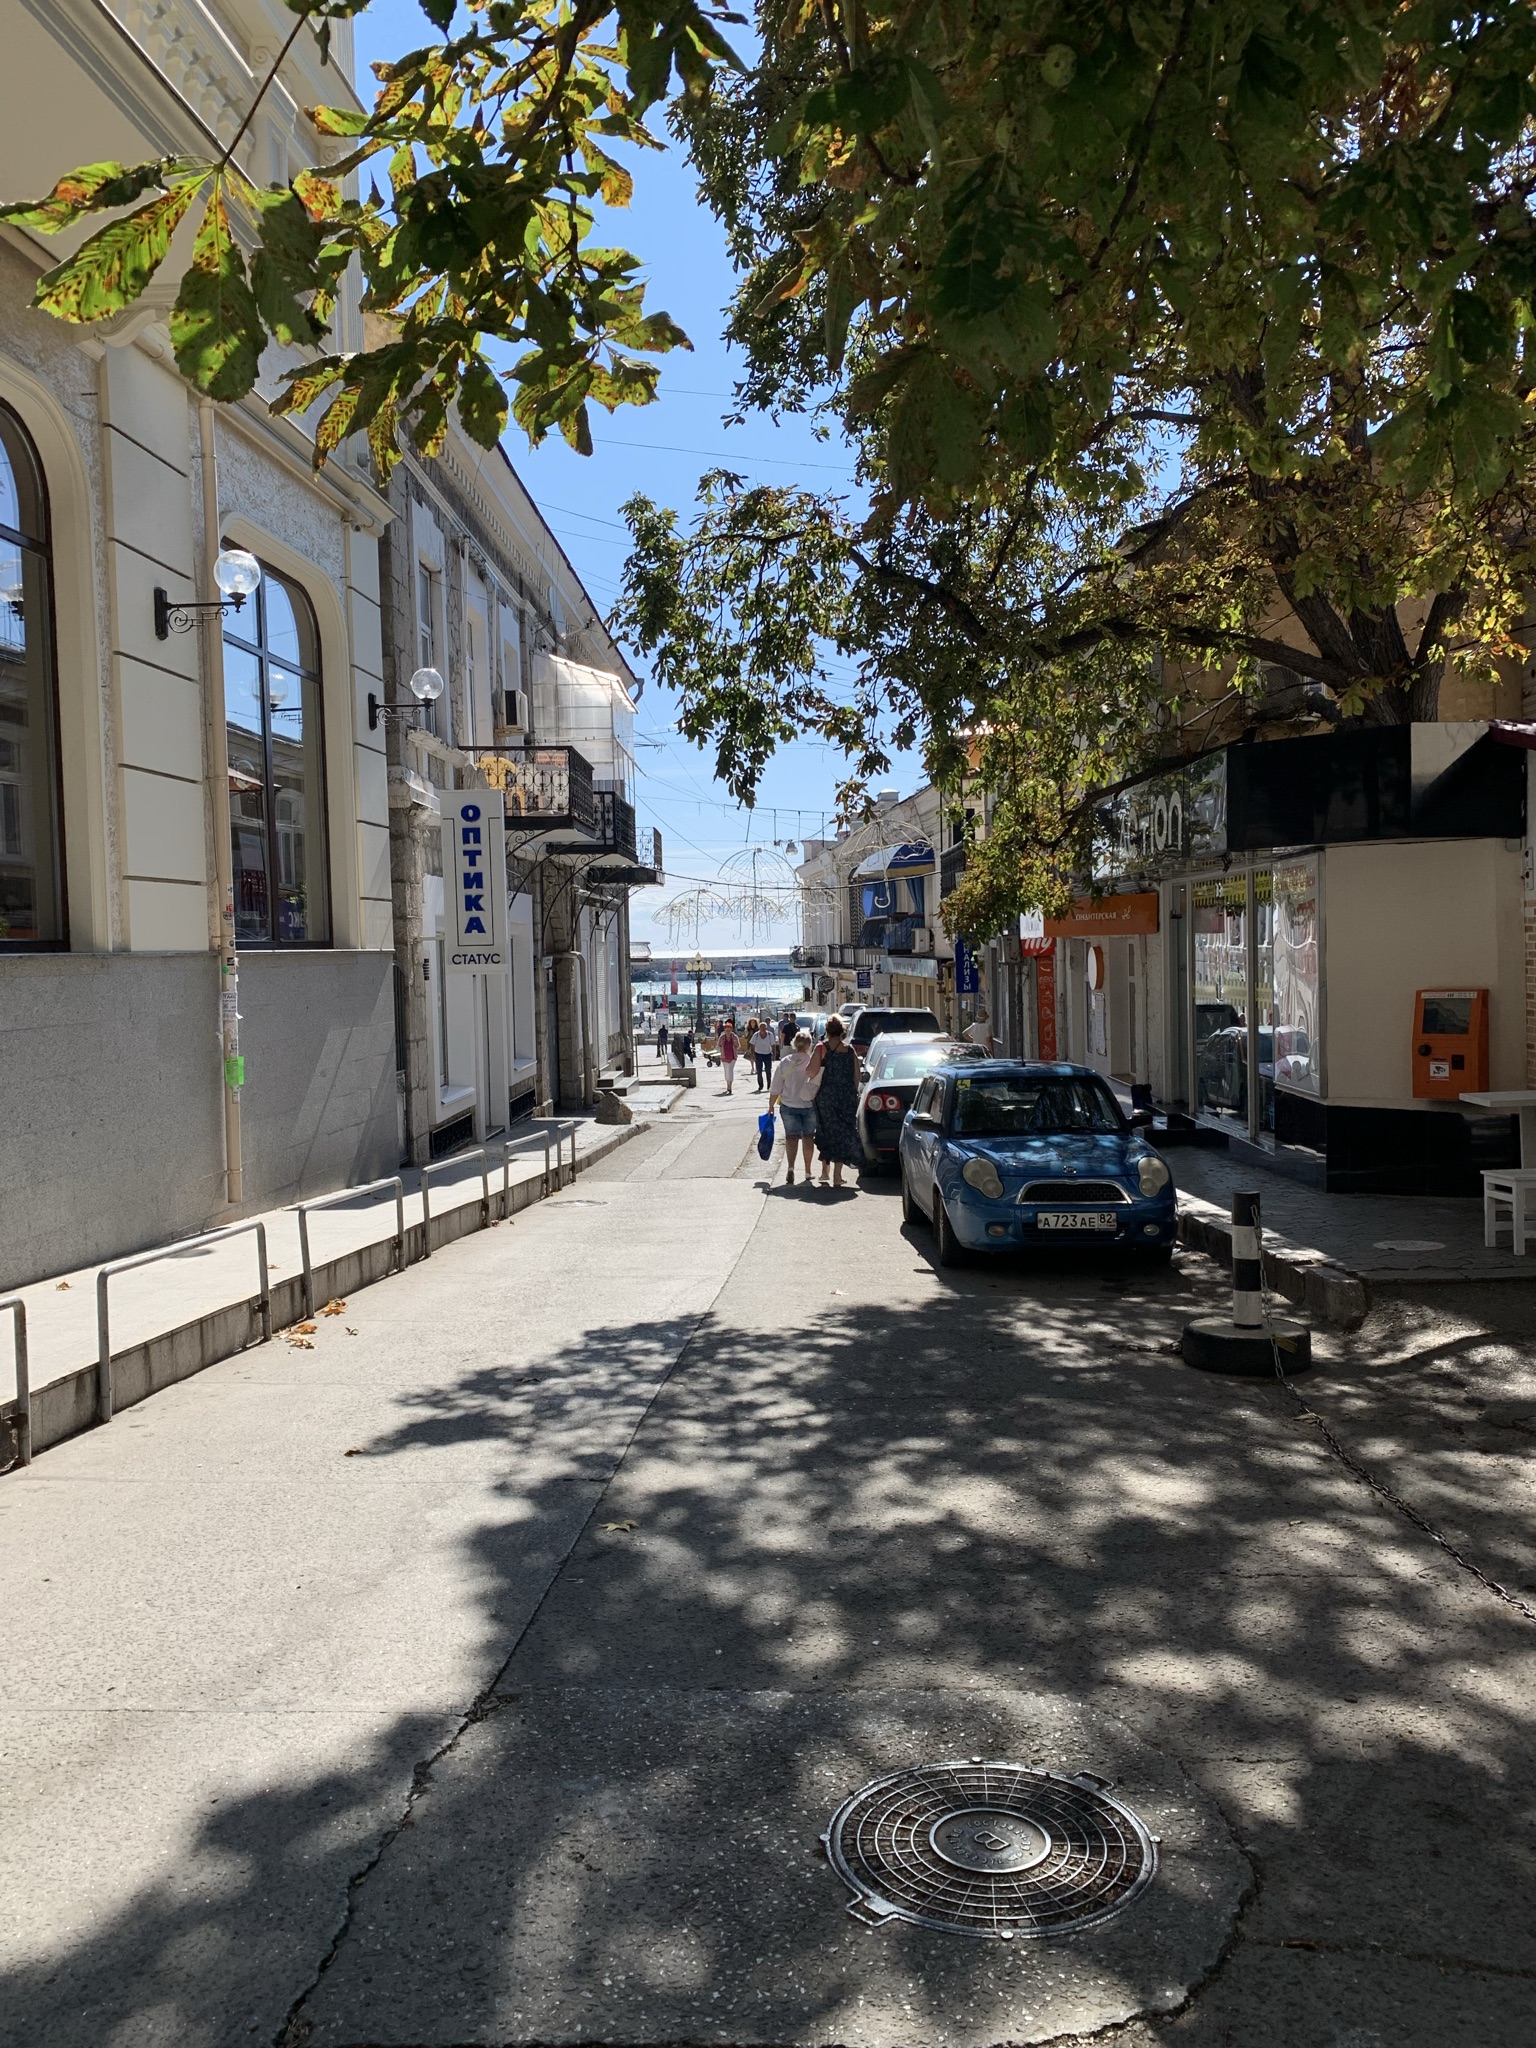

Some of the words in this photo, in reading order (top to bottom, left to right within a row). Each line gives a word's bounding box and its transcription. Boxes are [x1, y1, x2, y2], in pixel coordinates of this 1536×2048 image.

[460, 804, 487, 934] ОПТИКА
[1074, 911, 1117, 922] ОНДИТЕРСКАЯ
[451, 953, 501, 965] СТАТУС
[963, 943, 972, 991] НАЛИЗЫ
[1099, 1213, 1113, 1224] 82
